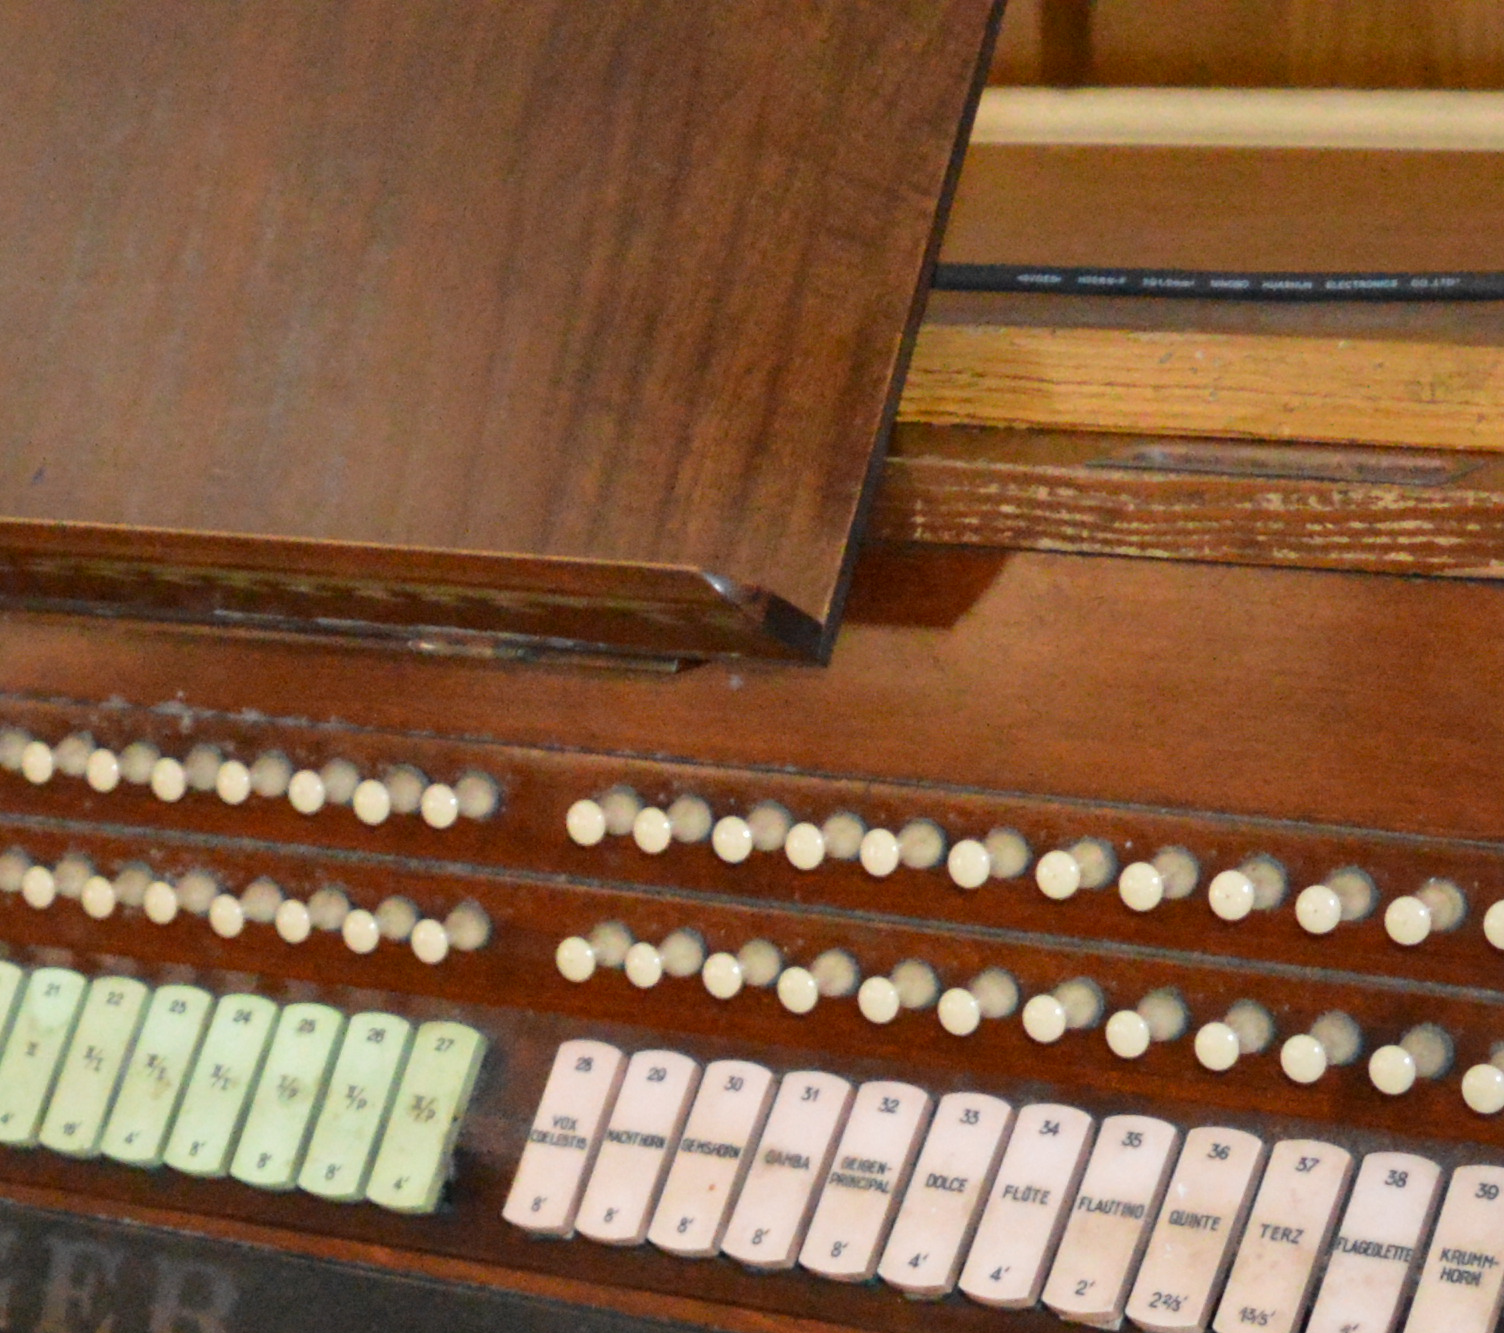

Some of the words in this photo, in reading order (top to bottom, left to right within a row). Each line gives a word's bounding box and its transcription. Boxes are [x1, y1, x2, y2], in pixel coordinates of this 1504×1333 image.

[232, 1008, 252, 1024] 24
[434, 1037, 455, 1052] 27
[575, 1056, 594, 1072] 28
[646, 1066, 667, 1082] 29
[723, 1074, 744, 1092] 30
[801, 1086, 820, 1102] 31
[878, 1096, 900, 1114] 32
[552, 1115, 579, 1132] VOX
[959, 1108, 980, 1125] 33
[1039, 1120, 1060, 1137] 34
[1121, 1131, 1144, 1148] 35
[764, 1150, 810, 1170] GAMBA
[1207, 1143, 1231, 1160] 36
[1295, 1156, 1320, 1173] 37
[828, 1172, 890, 1194] PRINCIPAL
[925, 1172, 968, 1193] DOLCE
[1384, 1169, 1408, 1188] 38
[1002, 1183, 1051, 1205] FLÖTE
[1475, 1182, 1499, 1200] 39
[1077, 1195, 1145, 1220] FLAUTINO
[1168, 1209, 1221, 1231] QUINTE
[1260, 1222, 1305, 1245] TERZ
[1336, 1235, 1414, 1263] FLAGEOLETTE
[1439, 1247, 1499, 1269] KRUMM-
[1440, 1267, 1482, 1287] HORN
